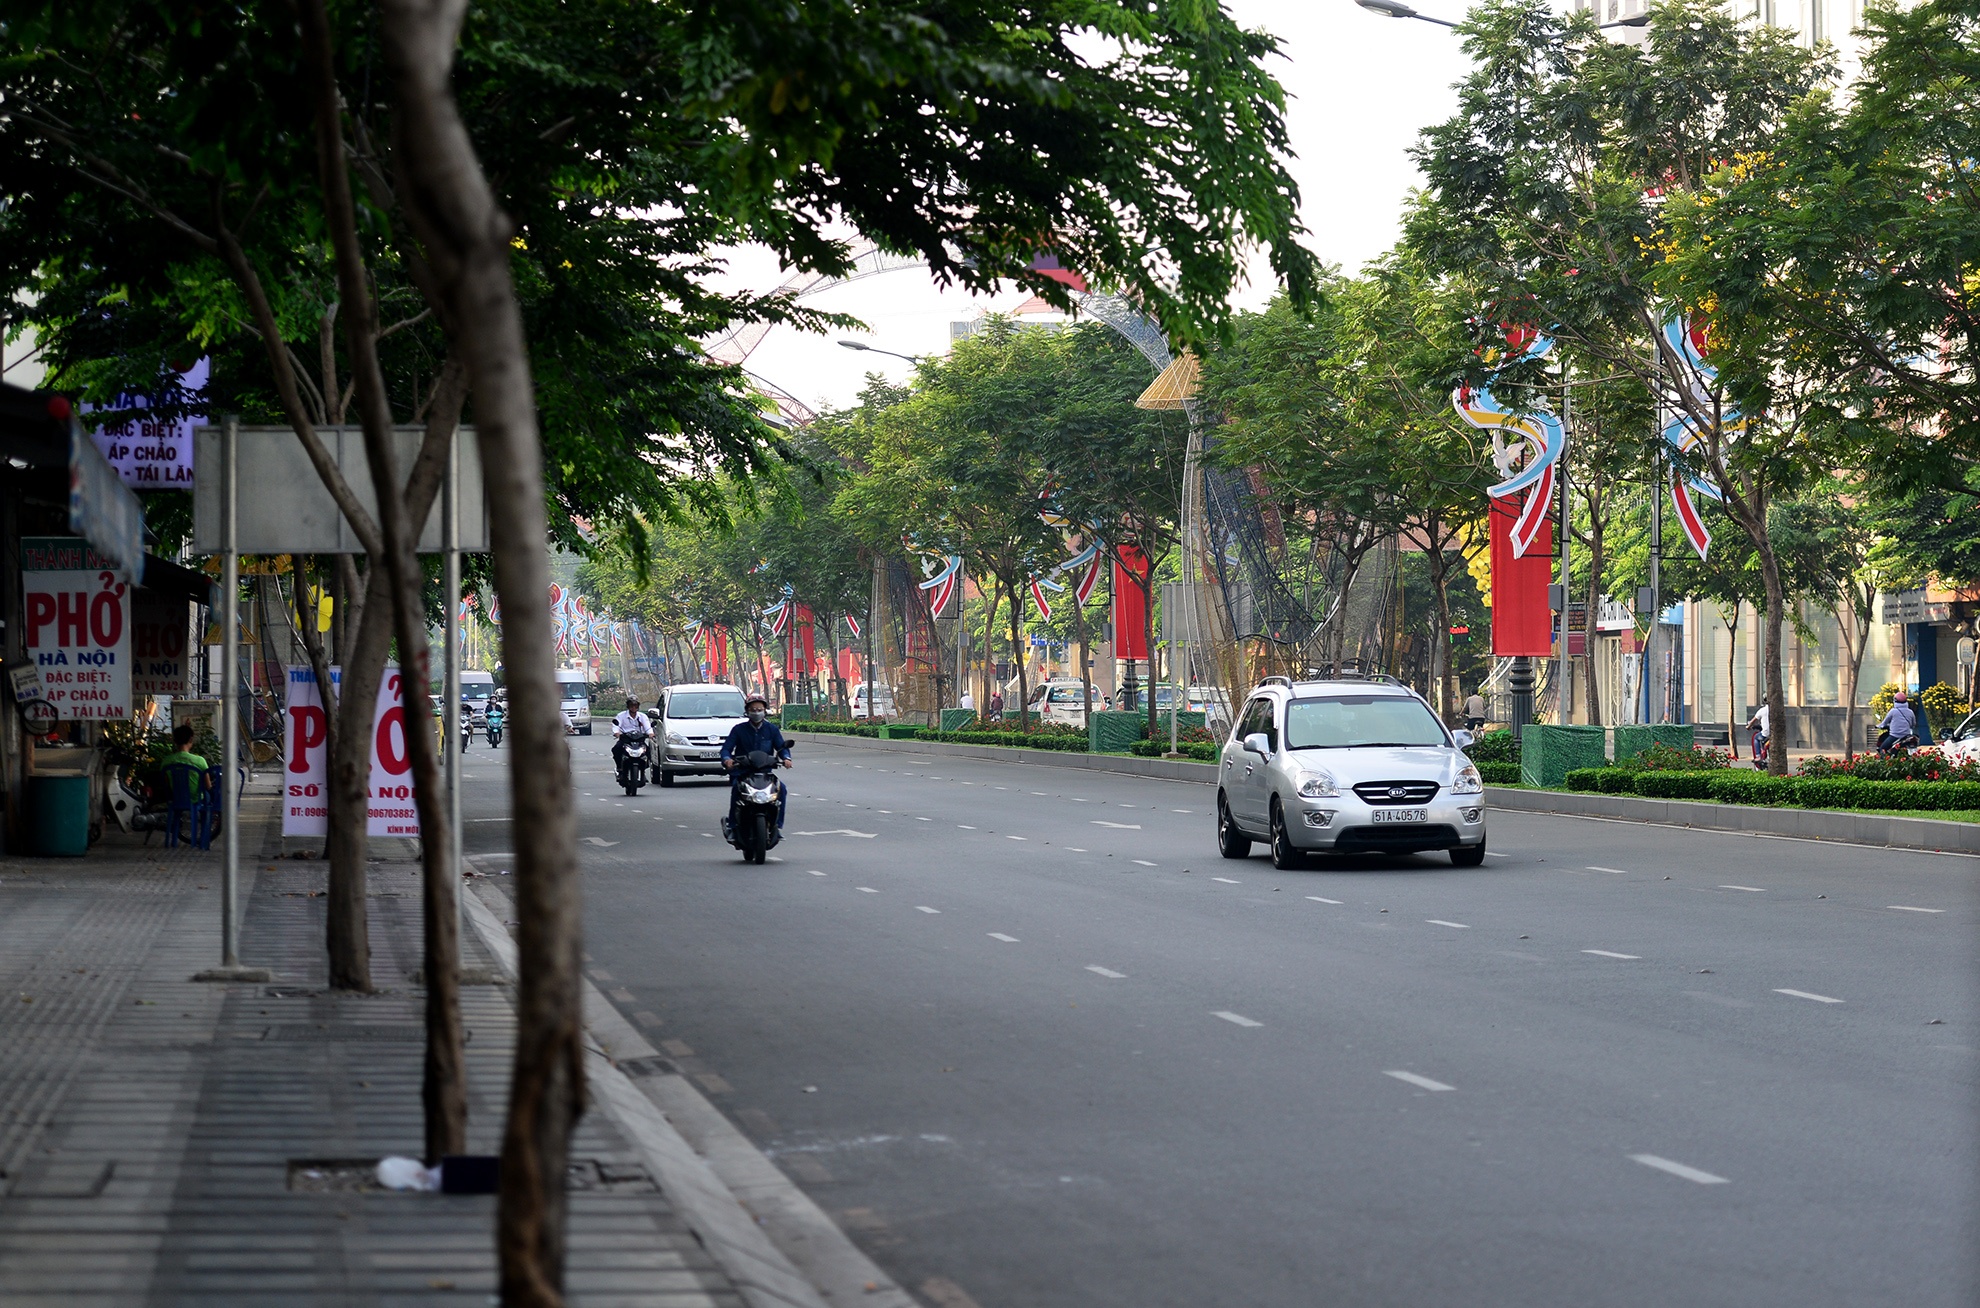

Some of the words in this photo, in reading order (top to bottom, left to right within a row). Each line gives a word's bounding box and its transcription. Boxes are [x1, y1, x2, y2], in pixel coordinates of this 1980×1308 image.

[142, 421, 182, 441] BIỆT:
[109, 442, 129, 459] ÁP
[134, 442, 177, 460] CHẢO
[135, 464, 159, 481] TÁI
[25, 543, 81, 569] THÀNH
[26, 571, 125, 647] PHỞ
[132, 607, 184, 658] HỞ
[39, 650, 68, 665] HÀ
[78, 649, 115, 667] NỘI
[150, 660, 178, 678] NỘI
[46, 670, 73, 685] ĐẶC
[77, 670, 111, 685] BIỆT:
[46, 688, 66, 701] ÁP
[70, 687, 109, 701] CHẢO
[160, 681, 183, 691] 24/24
[72, 704, 93, 718] TÁI
[98, 704, 123, 718] LĂN
[289, 782, 322, 797] SỐ
[367, 809, 415, 818] 906703882
[1375, 810, 1426, 821] 51A-405.76
[387, 824, 404, 834] KÍNH
